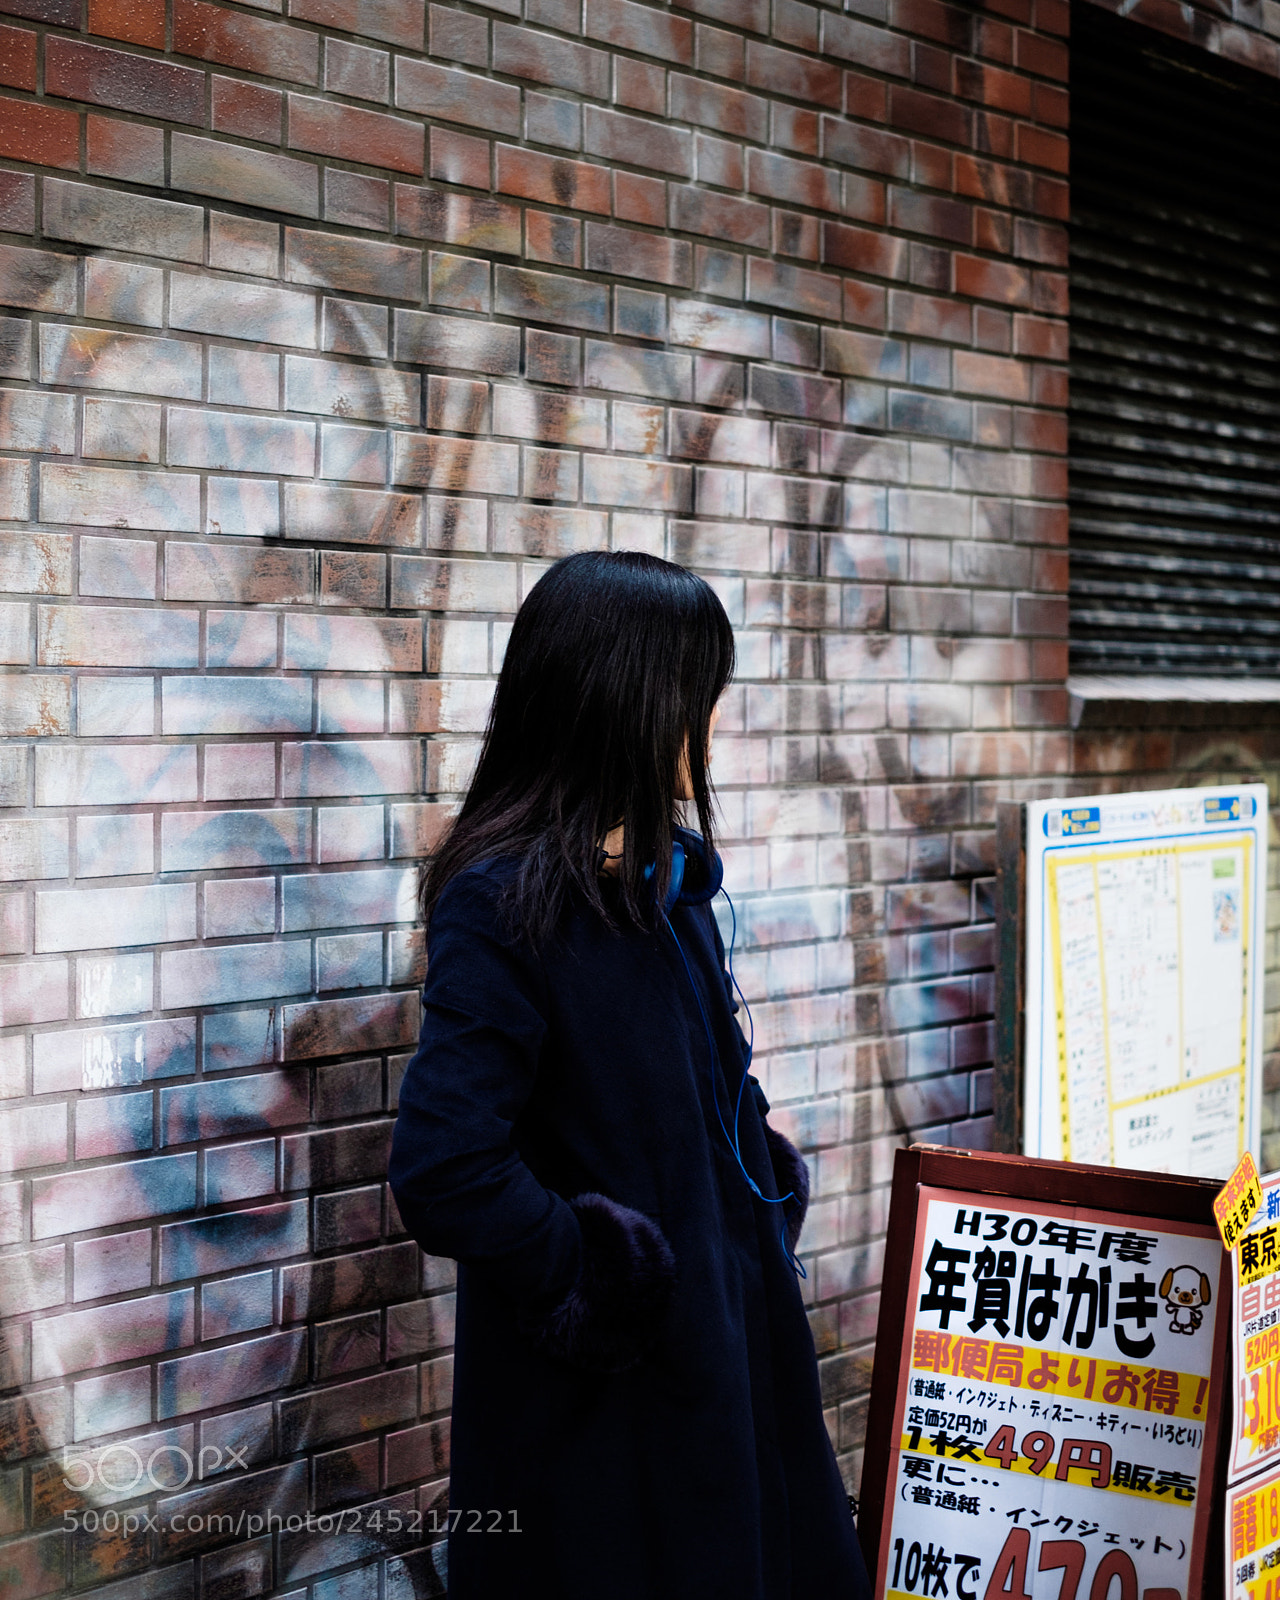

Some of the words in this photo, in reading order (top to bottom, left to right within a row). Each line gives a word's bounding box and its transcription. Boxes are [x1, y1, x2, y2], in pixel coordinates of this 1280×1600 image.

[953, 1208, 1159, 1265] H30年度
[1240, 1226, 1280, 1276] 東京
[919, 1238, 1158, 1359] 年賀はがき
[912, 1329, 1210, 1415] 郵便局よりお得！
[908, 1406, 987, 1435] 定価52円が
[891, 1527, 1182, 1600] 10枚で470
